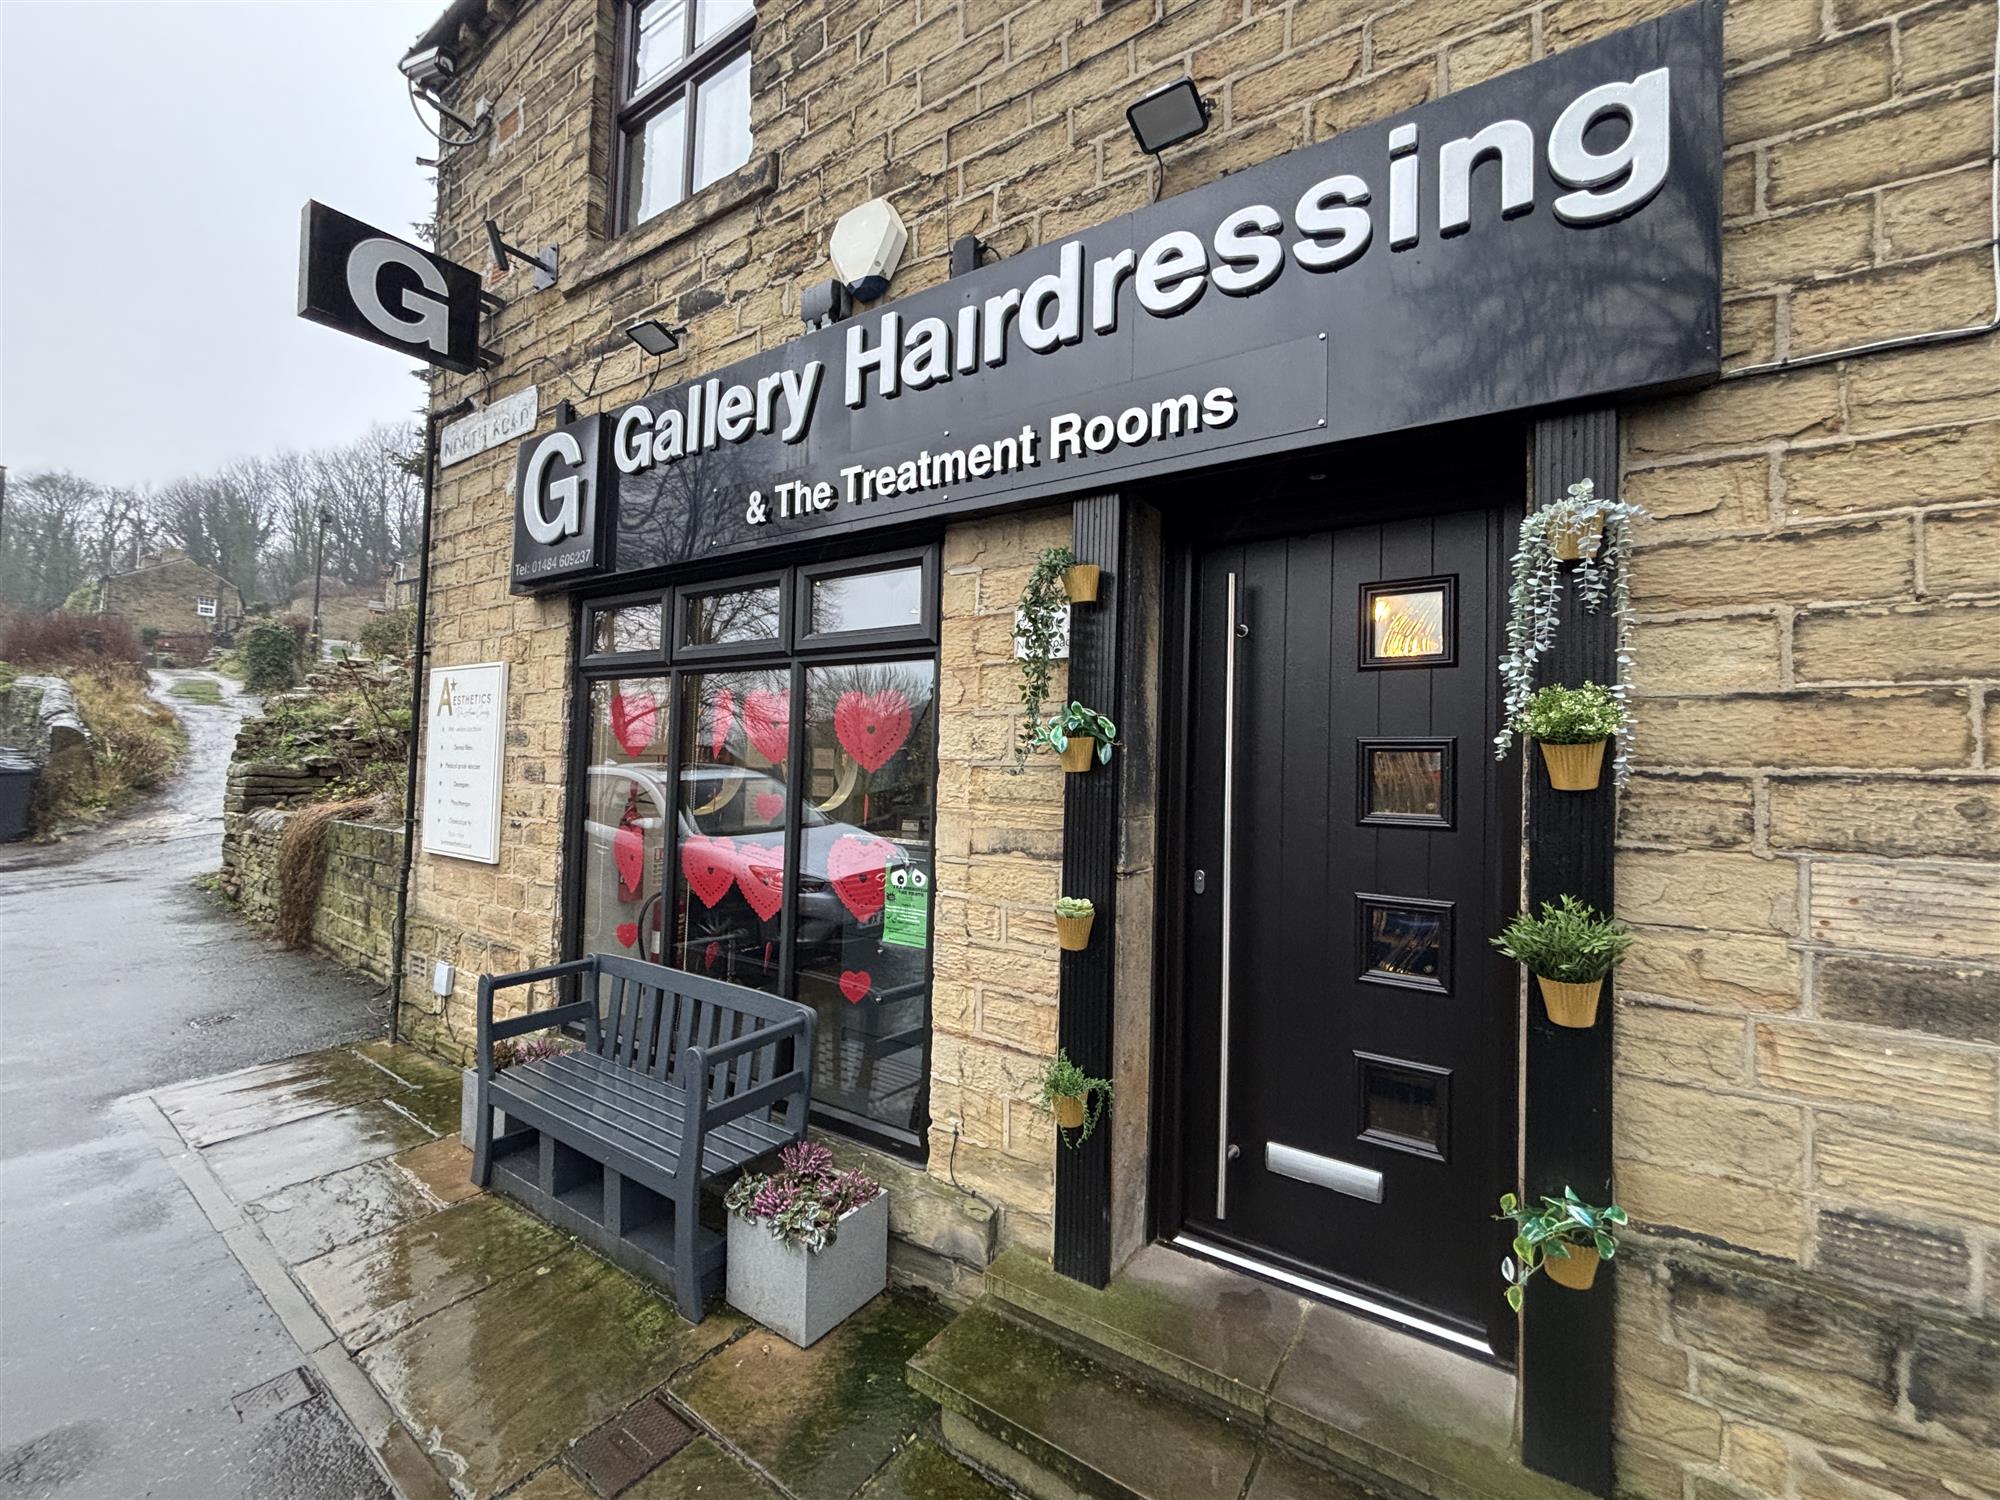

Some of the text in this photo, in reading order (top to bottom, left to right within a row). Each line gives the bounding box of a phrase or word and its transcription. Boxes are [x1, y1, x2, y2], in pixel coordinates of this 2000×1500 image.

[346, 238, 449, 355] G
[613, 67, 1670, 474] Gallery Hairdressing
[444, 408, 529, 458] NORTH ROAD
[523, 431, 583, 545] G
[746, 386, 1237, 525] & The Treatment Rooms
[515, 549, 591, 576] Tel: 01484 609237
